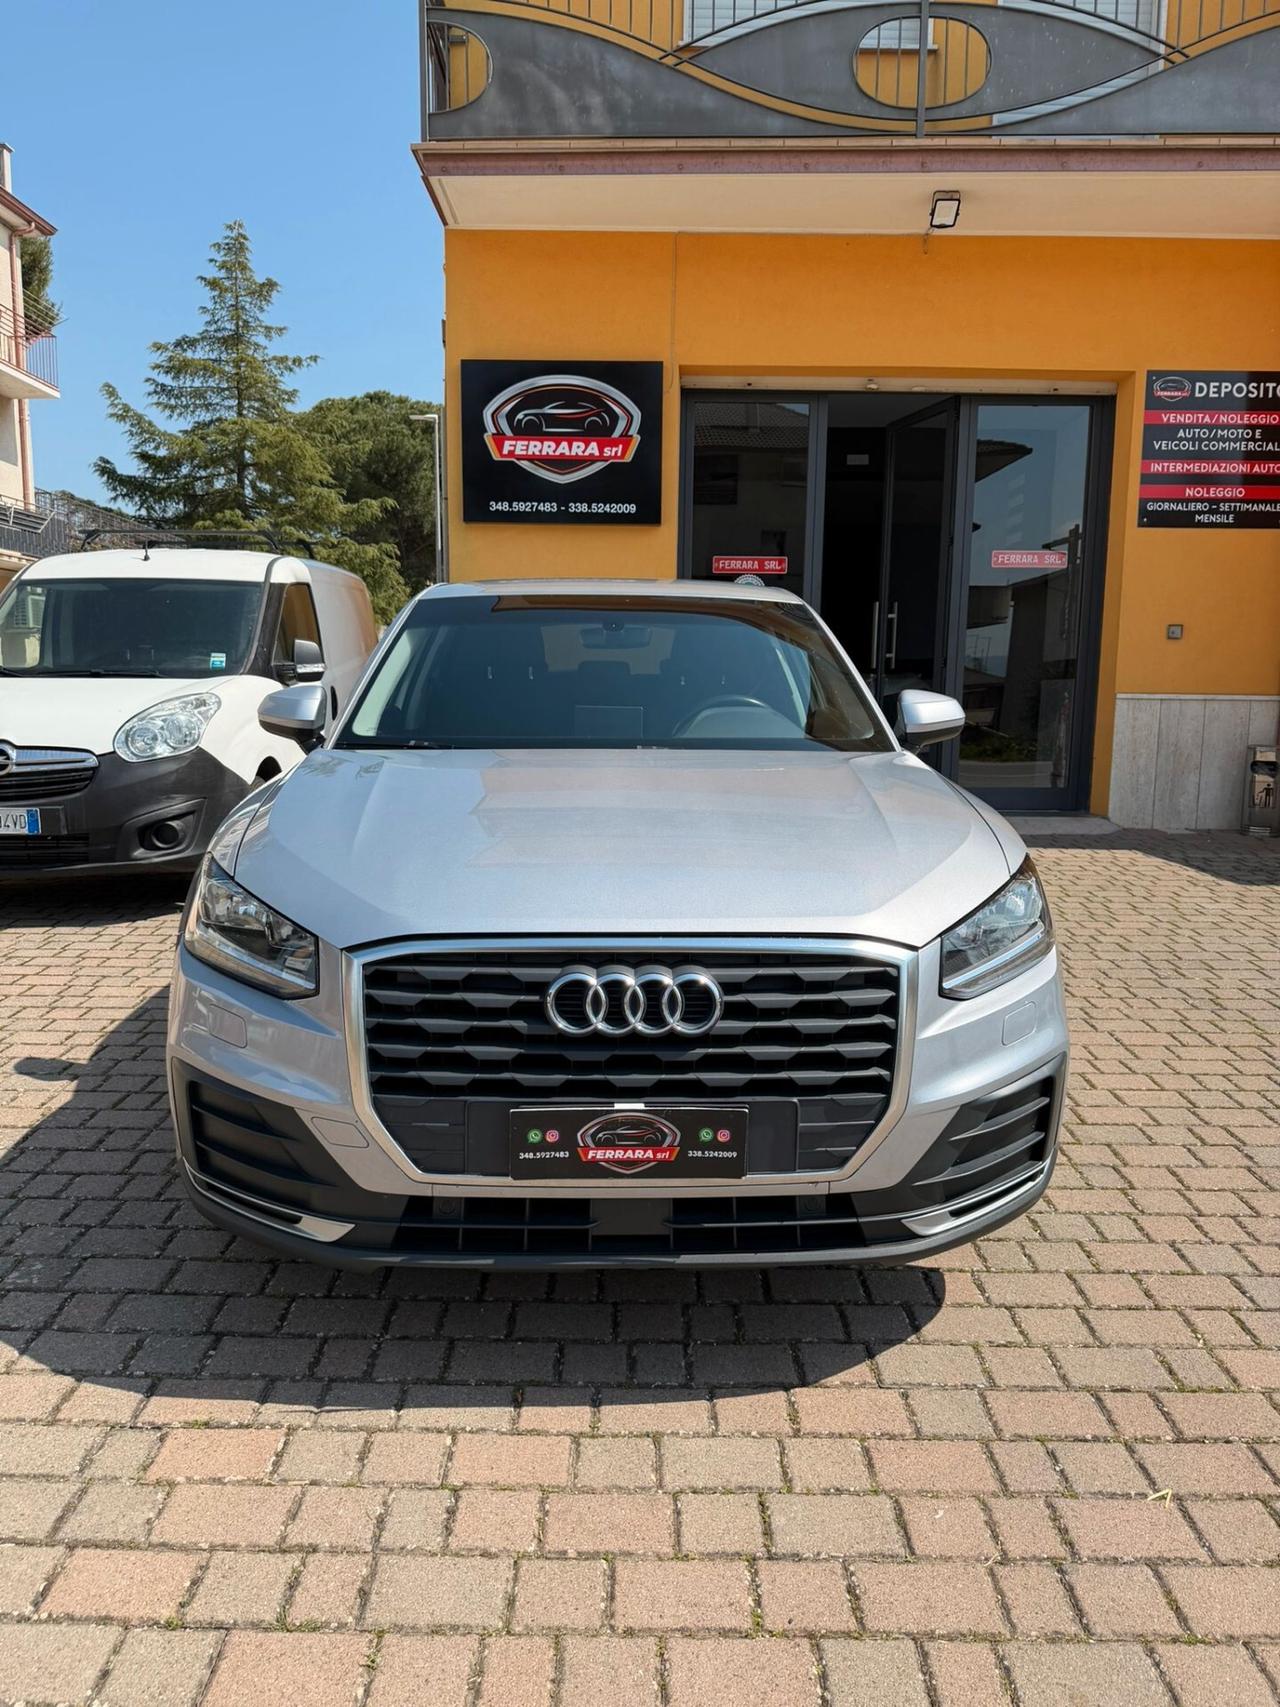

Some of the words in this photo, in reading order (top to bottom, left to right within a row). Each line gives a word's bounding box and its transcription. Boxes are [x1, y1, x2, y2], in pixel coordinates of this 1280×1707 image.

[1195, 382, 1280, 398] DEPOSIT
[1162, 413, 1279, 424] VENDITA/NOLEGGIO
[1177, 428, 1253, 439] AUTO/MOTO
[1255, 429, 1262, 439] E
[502, 440, 600, 457] FERRARA
[603, 444, 622, 457] srl
[1153, 440, 1199, 451] VEICOLI
[1150, 462, 1250, 473] INTERMEDIAZIONI
[1185, 487, 1245, 498] NOLEGGIO
[489, 501, 558, 513] 348.5927483
[568, 503, 637, 514] 338.5242009
[1147, 502, 1209, 511] GIORNALIERO
[1219, 502, 1280, 512] SETTIMANALE
[1195, 514, 1234, 523] MENSILE
[998, 554, 1038, 563] FERRARA
[1044, 554, 1062, 564] SRL
[719, 560, 759, 570] FERRARA
[764, 560, 782, 570] SRL
[0, 814, 27, 829] 4VD
[519, 1151, 570, 1160] 348.5927483
[587, 1149, 654, 1160] FERRARA
[656, 1151, 670, 1160] srl
[687, 1150, 738, 1159] 338.5242009
